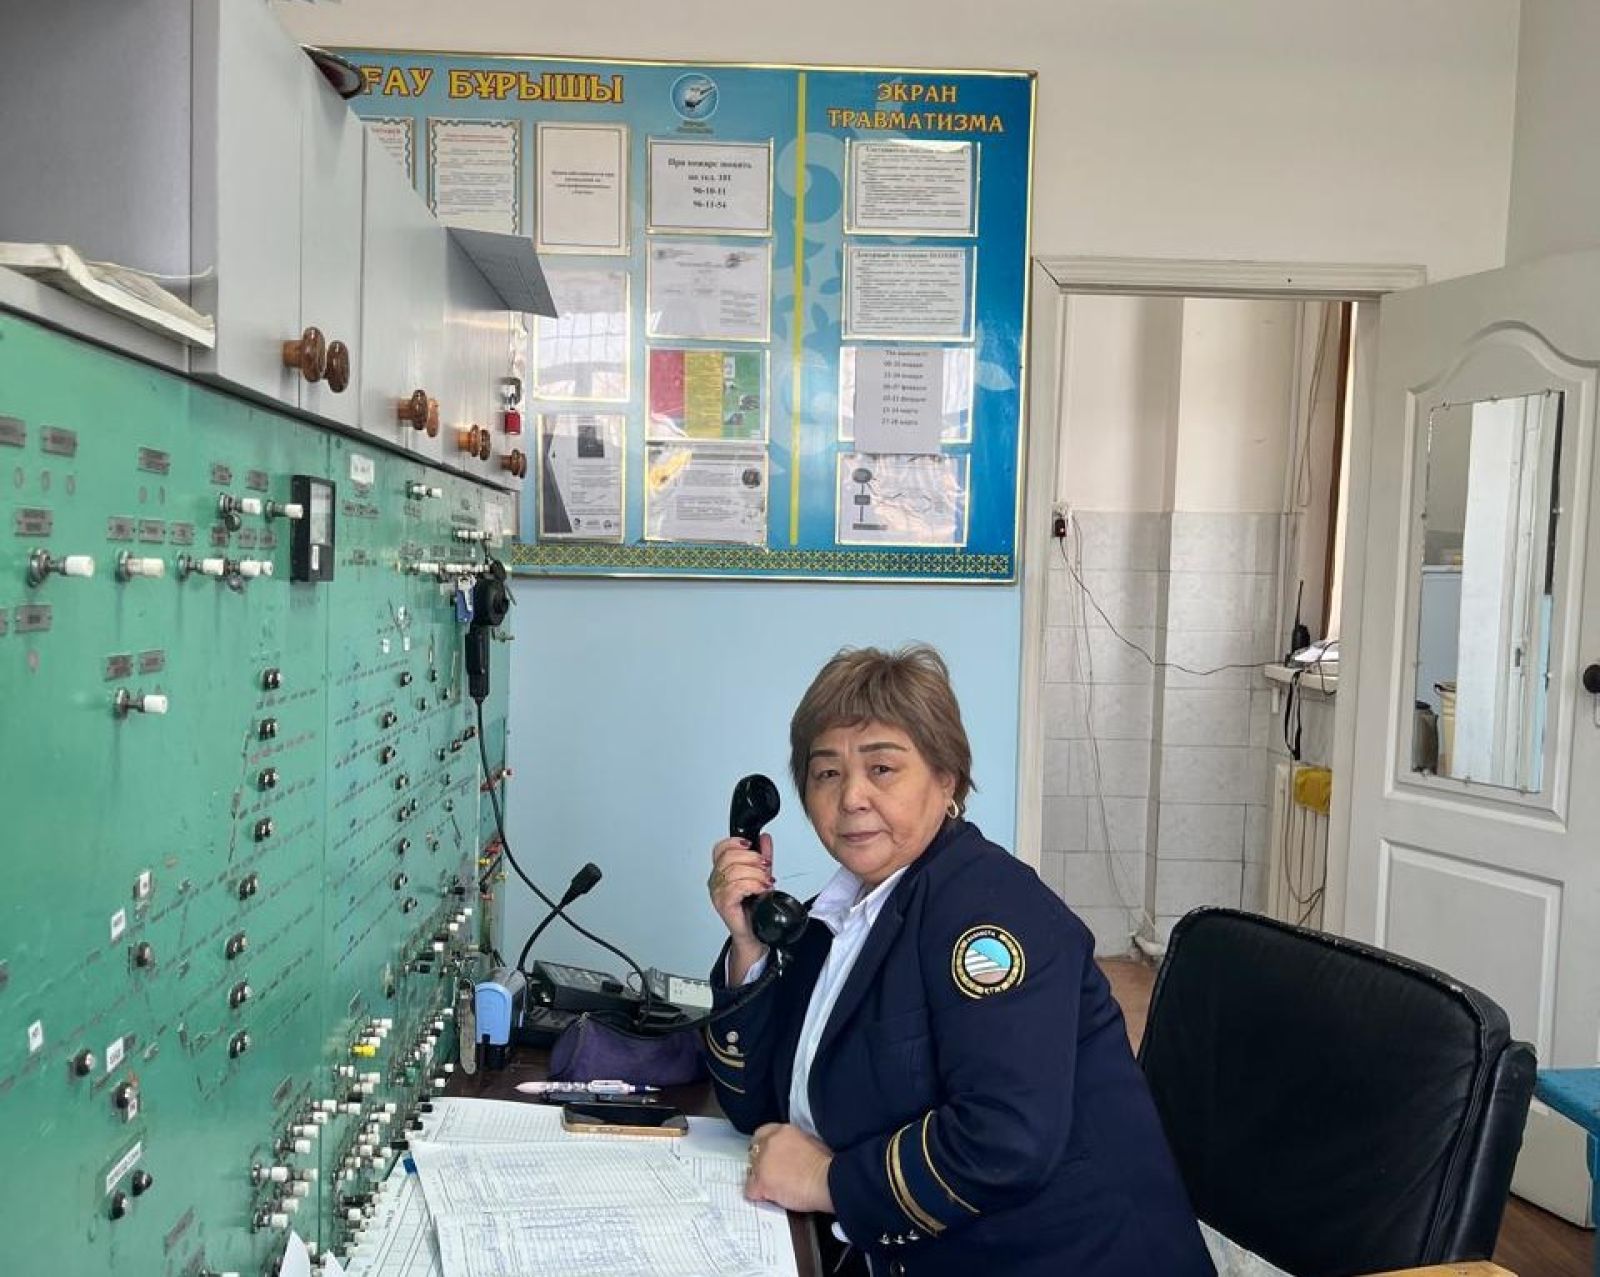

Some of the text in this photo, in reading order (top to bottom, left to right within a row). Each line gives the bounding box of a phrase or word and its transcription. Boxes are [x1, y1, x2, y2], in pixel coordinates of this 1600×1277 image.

[449, 69, 624, 104] БҰРЫШЫ
[876, 82, 958, 103] ЭКРАН
[827, 108, 1005, 133] ТРАВМАТИЗМА
